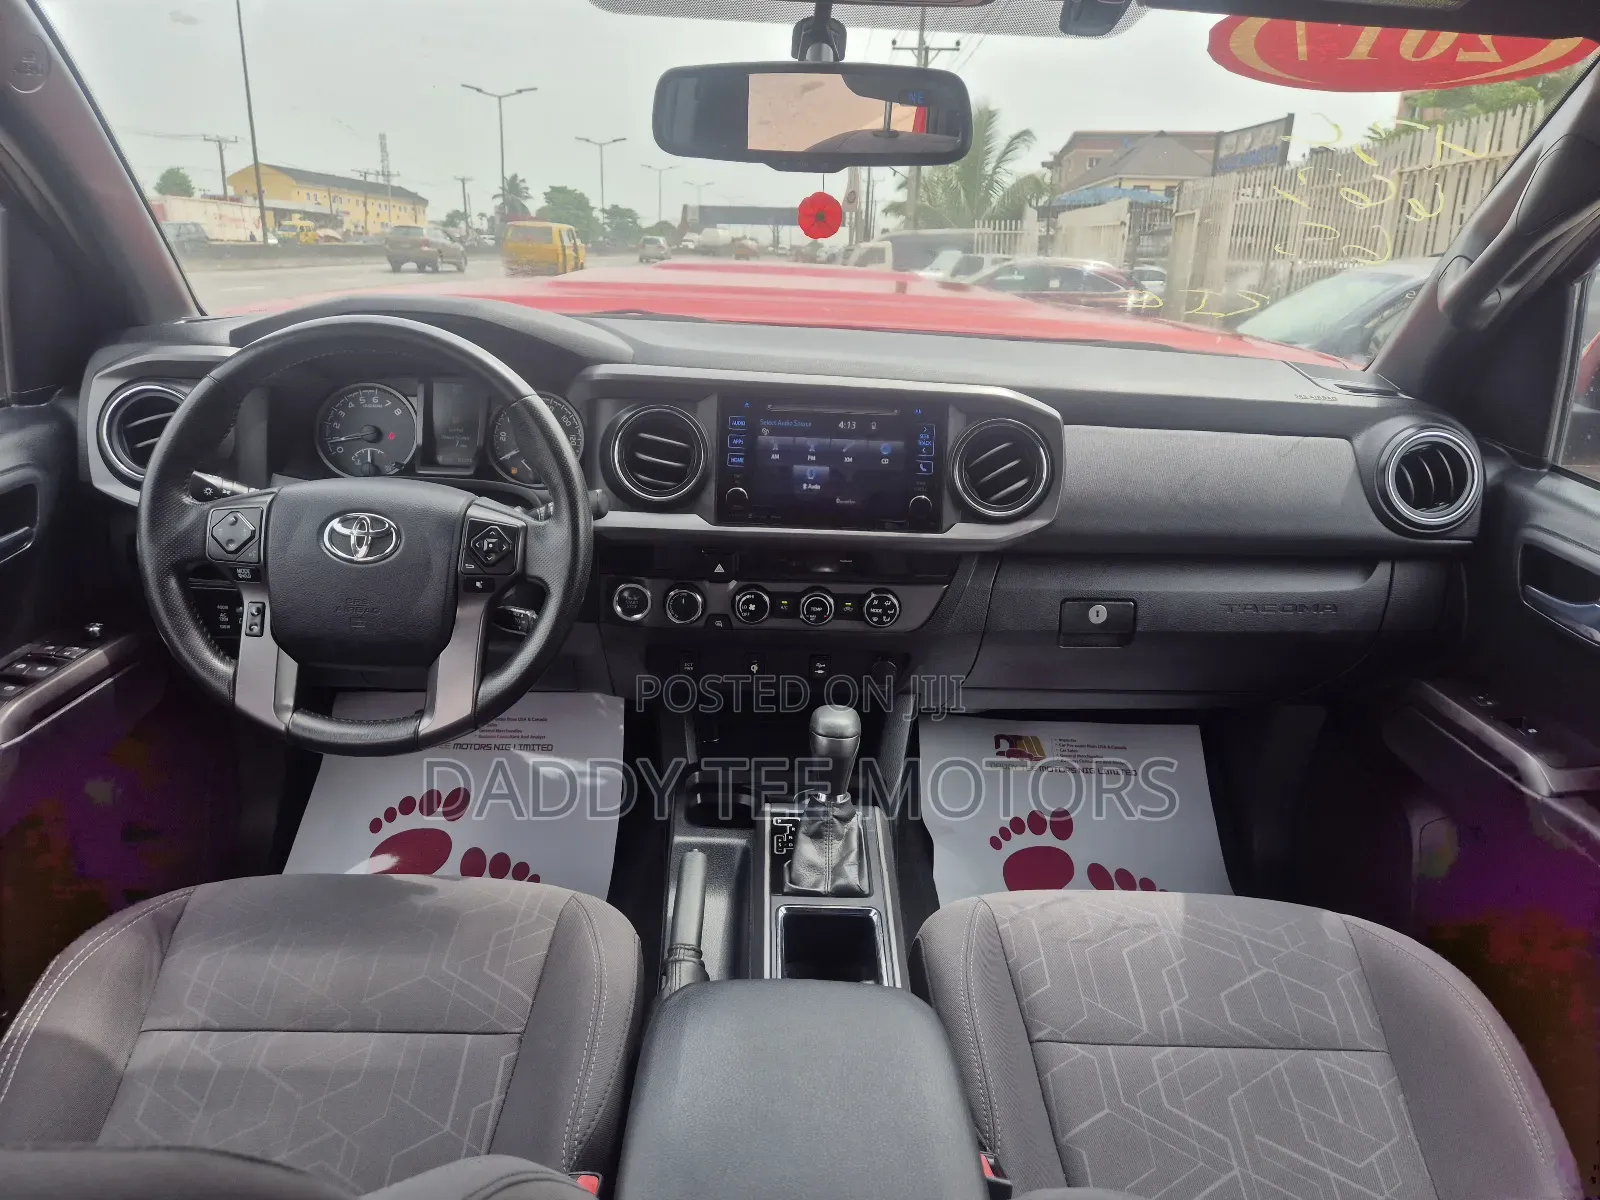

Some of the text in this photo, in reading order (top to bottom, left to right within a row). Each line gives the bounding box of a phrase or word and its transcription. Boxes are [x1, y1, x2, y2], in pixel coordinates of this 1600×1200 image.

[561, 415, 572, 427] 100
[838, 420, 857, 430] 4:13
[499, 431, 507, 442] 20
[569, 434, 577, 446] 120
[1219, 603, 1338, 615] TACOMA
[453, 743, 492, 751] MOTORS
[513, 744, 554, 752] LIMITED
